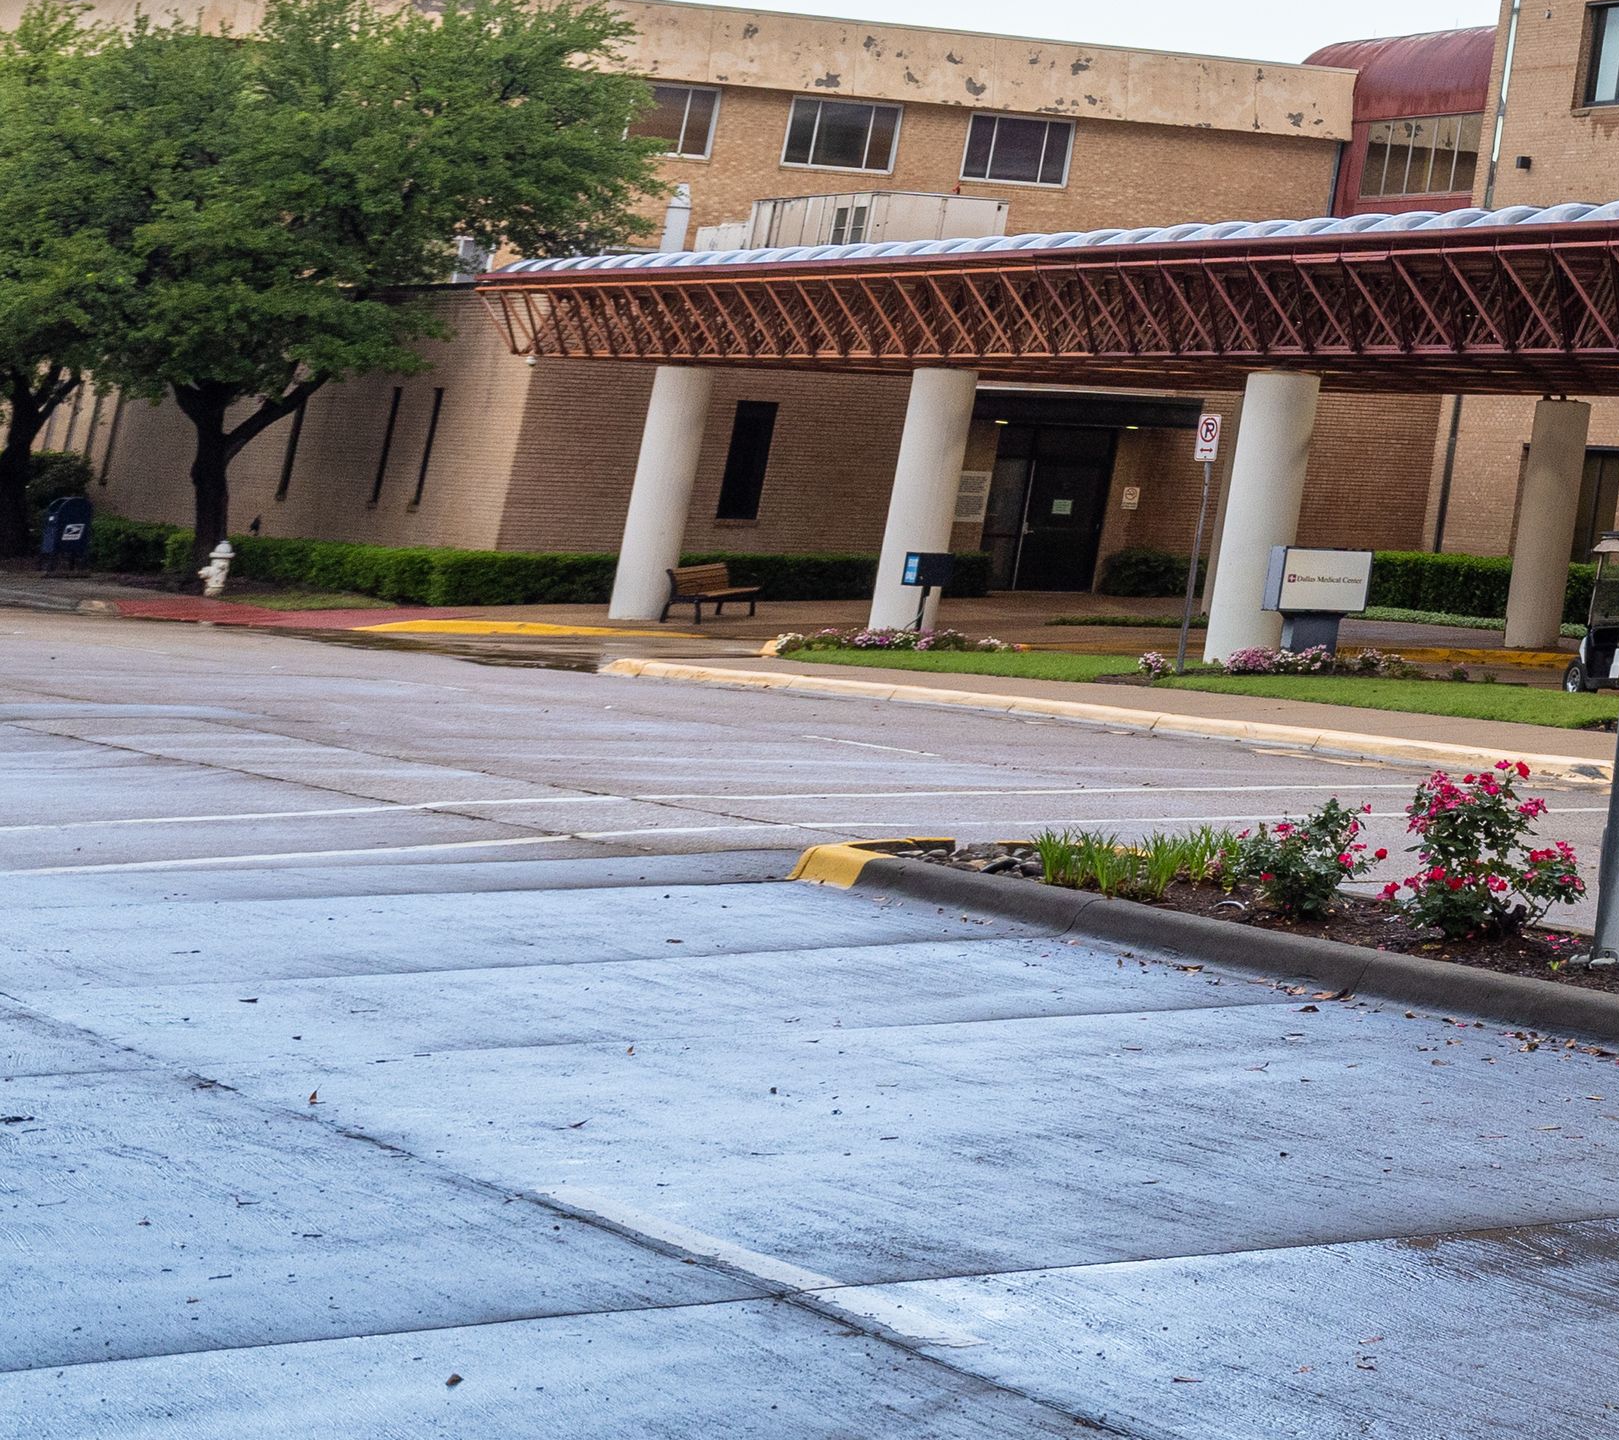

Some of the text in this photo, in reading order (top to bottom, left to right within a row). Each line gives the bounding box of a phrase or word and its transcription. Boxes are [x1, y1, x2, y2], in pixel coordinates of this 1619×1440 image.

[1297, 575, 1362, 585] Dallas Medical Center
